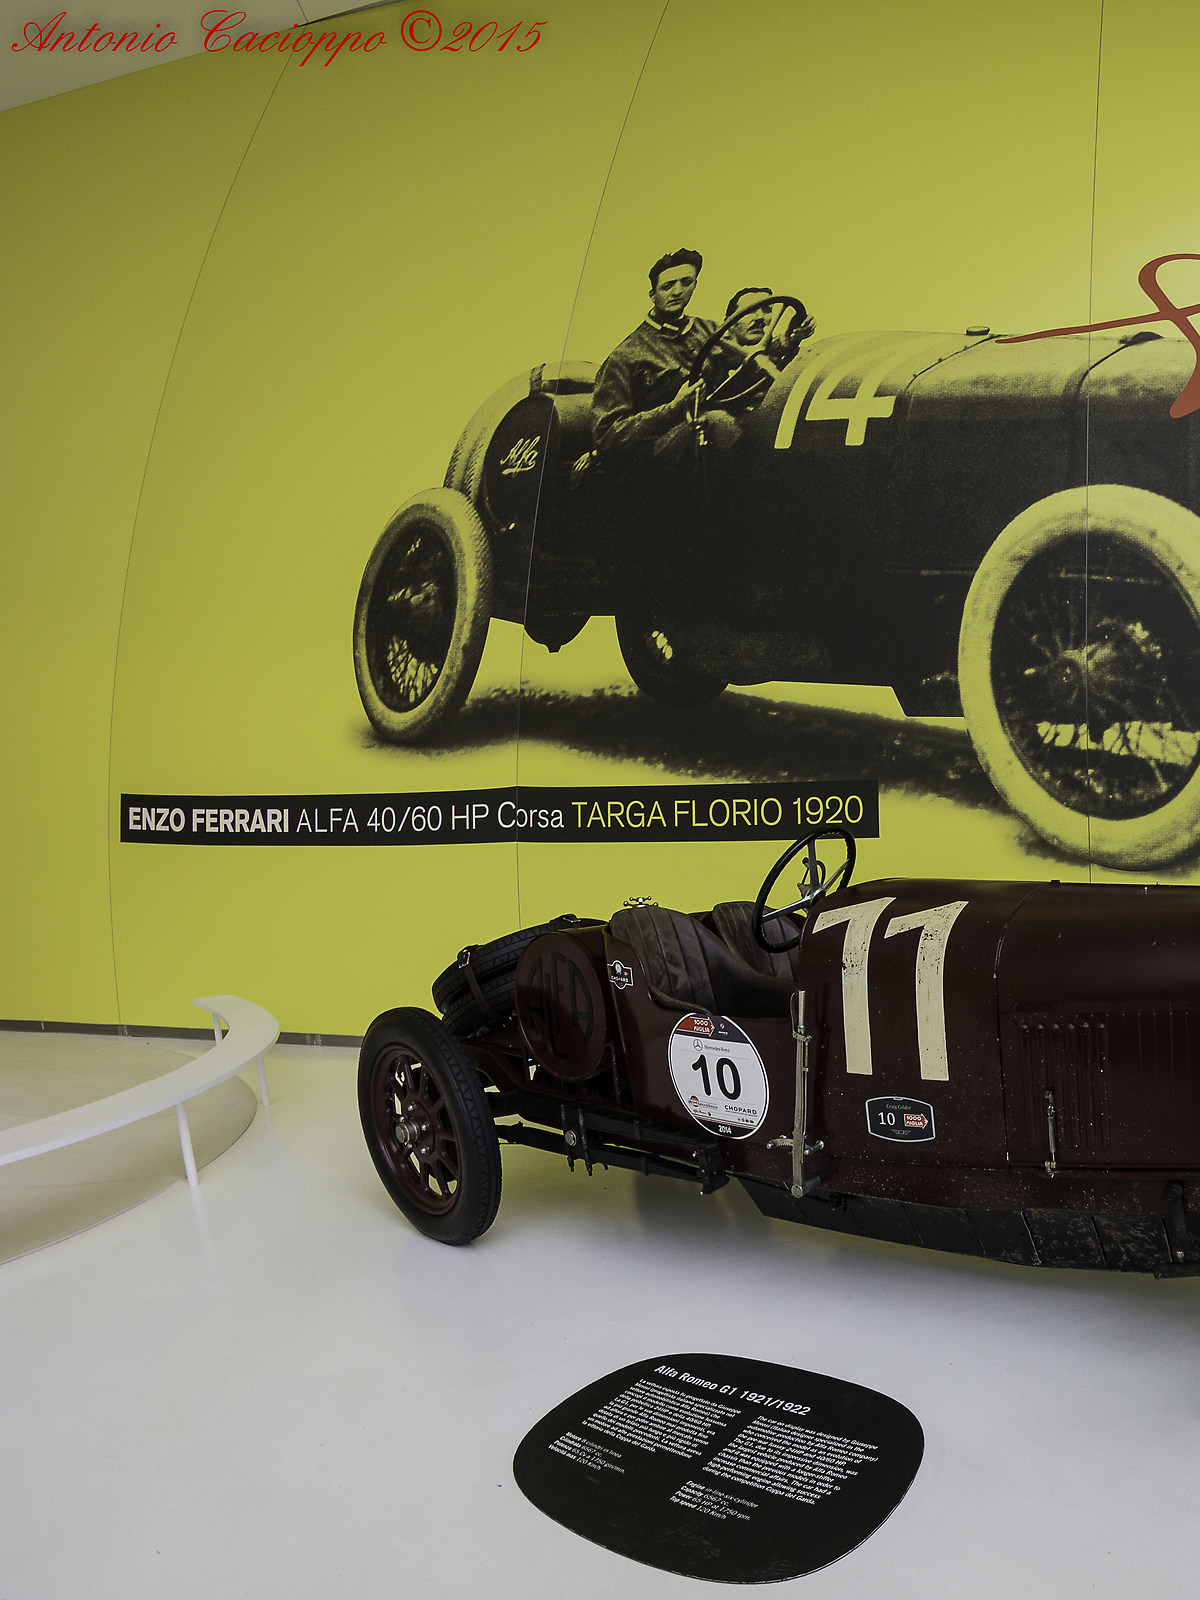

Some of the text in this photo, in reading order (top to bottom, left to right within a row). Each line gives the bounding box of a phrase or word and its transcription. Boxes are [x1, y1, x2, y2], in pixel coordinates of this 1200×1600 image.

[774, 338, 912, 449] 14
[500, 436, 540, 478] Alfa
[129, 795, 864, 833] ENZO FERRARI ALFA 40/60 HP Corsa TARGA FLORIO 1920
[812, 897, 969, 1081] 11
[691, 1054, 742, 1100] 10
[718, 1125, 732, 1134] 2014
[724, 1104, 758, 1115] CHOPARD
[878, 1111, 896, 1126] 10
[654, 1365, 811, 1416] Alfa Romeo G1 1921/1922
